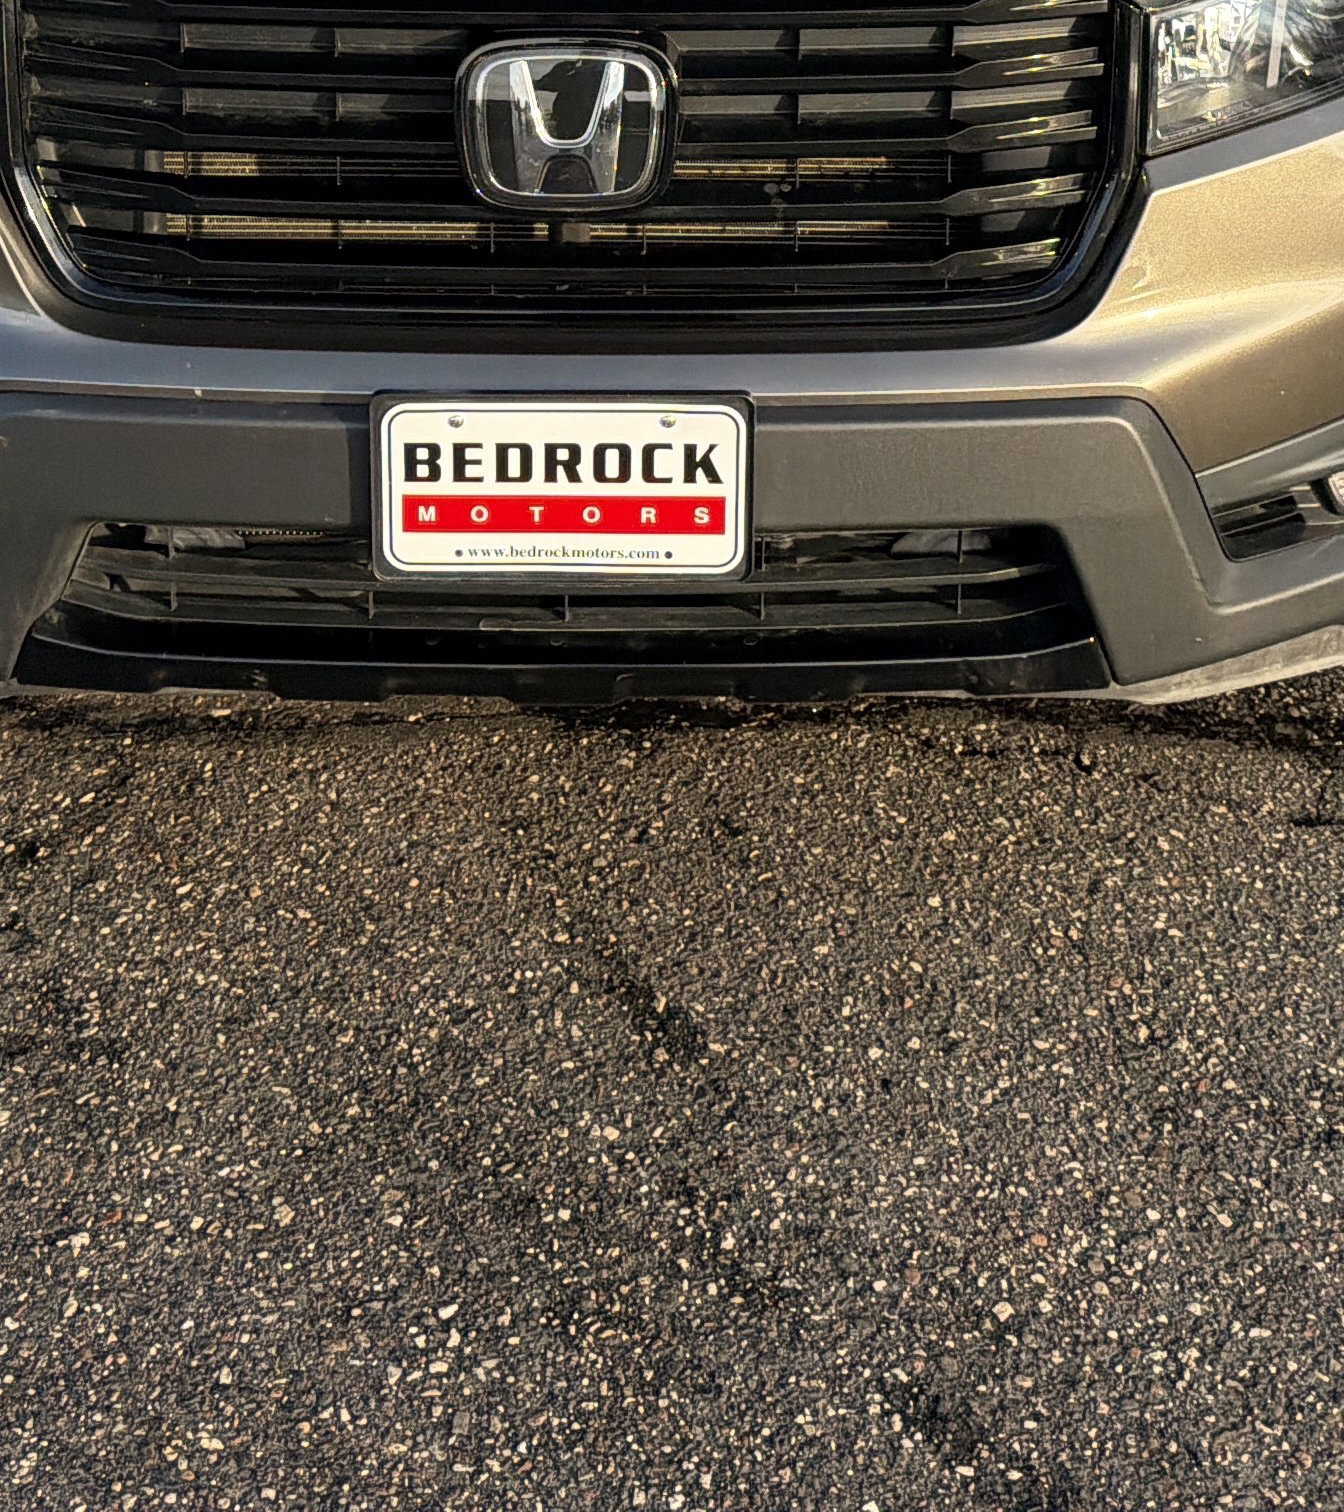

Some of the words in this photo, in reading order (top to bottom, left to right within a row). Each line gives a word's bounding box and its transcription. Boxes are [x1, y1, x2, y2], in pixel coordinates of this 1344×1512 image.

[403, 442, 724, 484] BEDROCK
[417, 505, 711, 524] MOTORS
[468, 545, 660, 560] www.bedrockmotors.com
